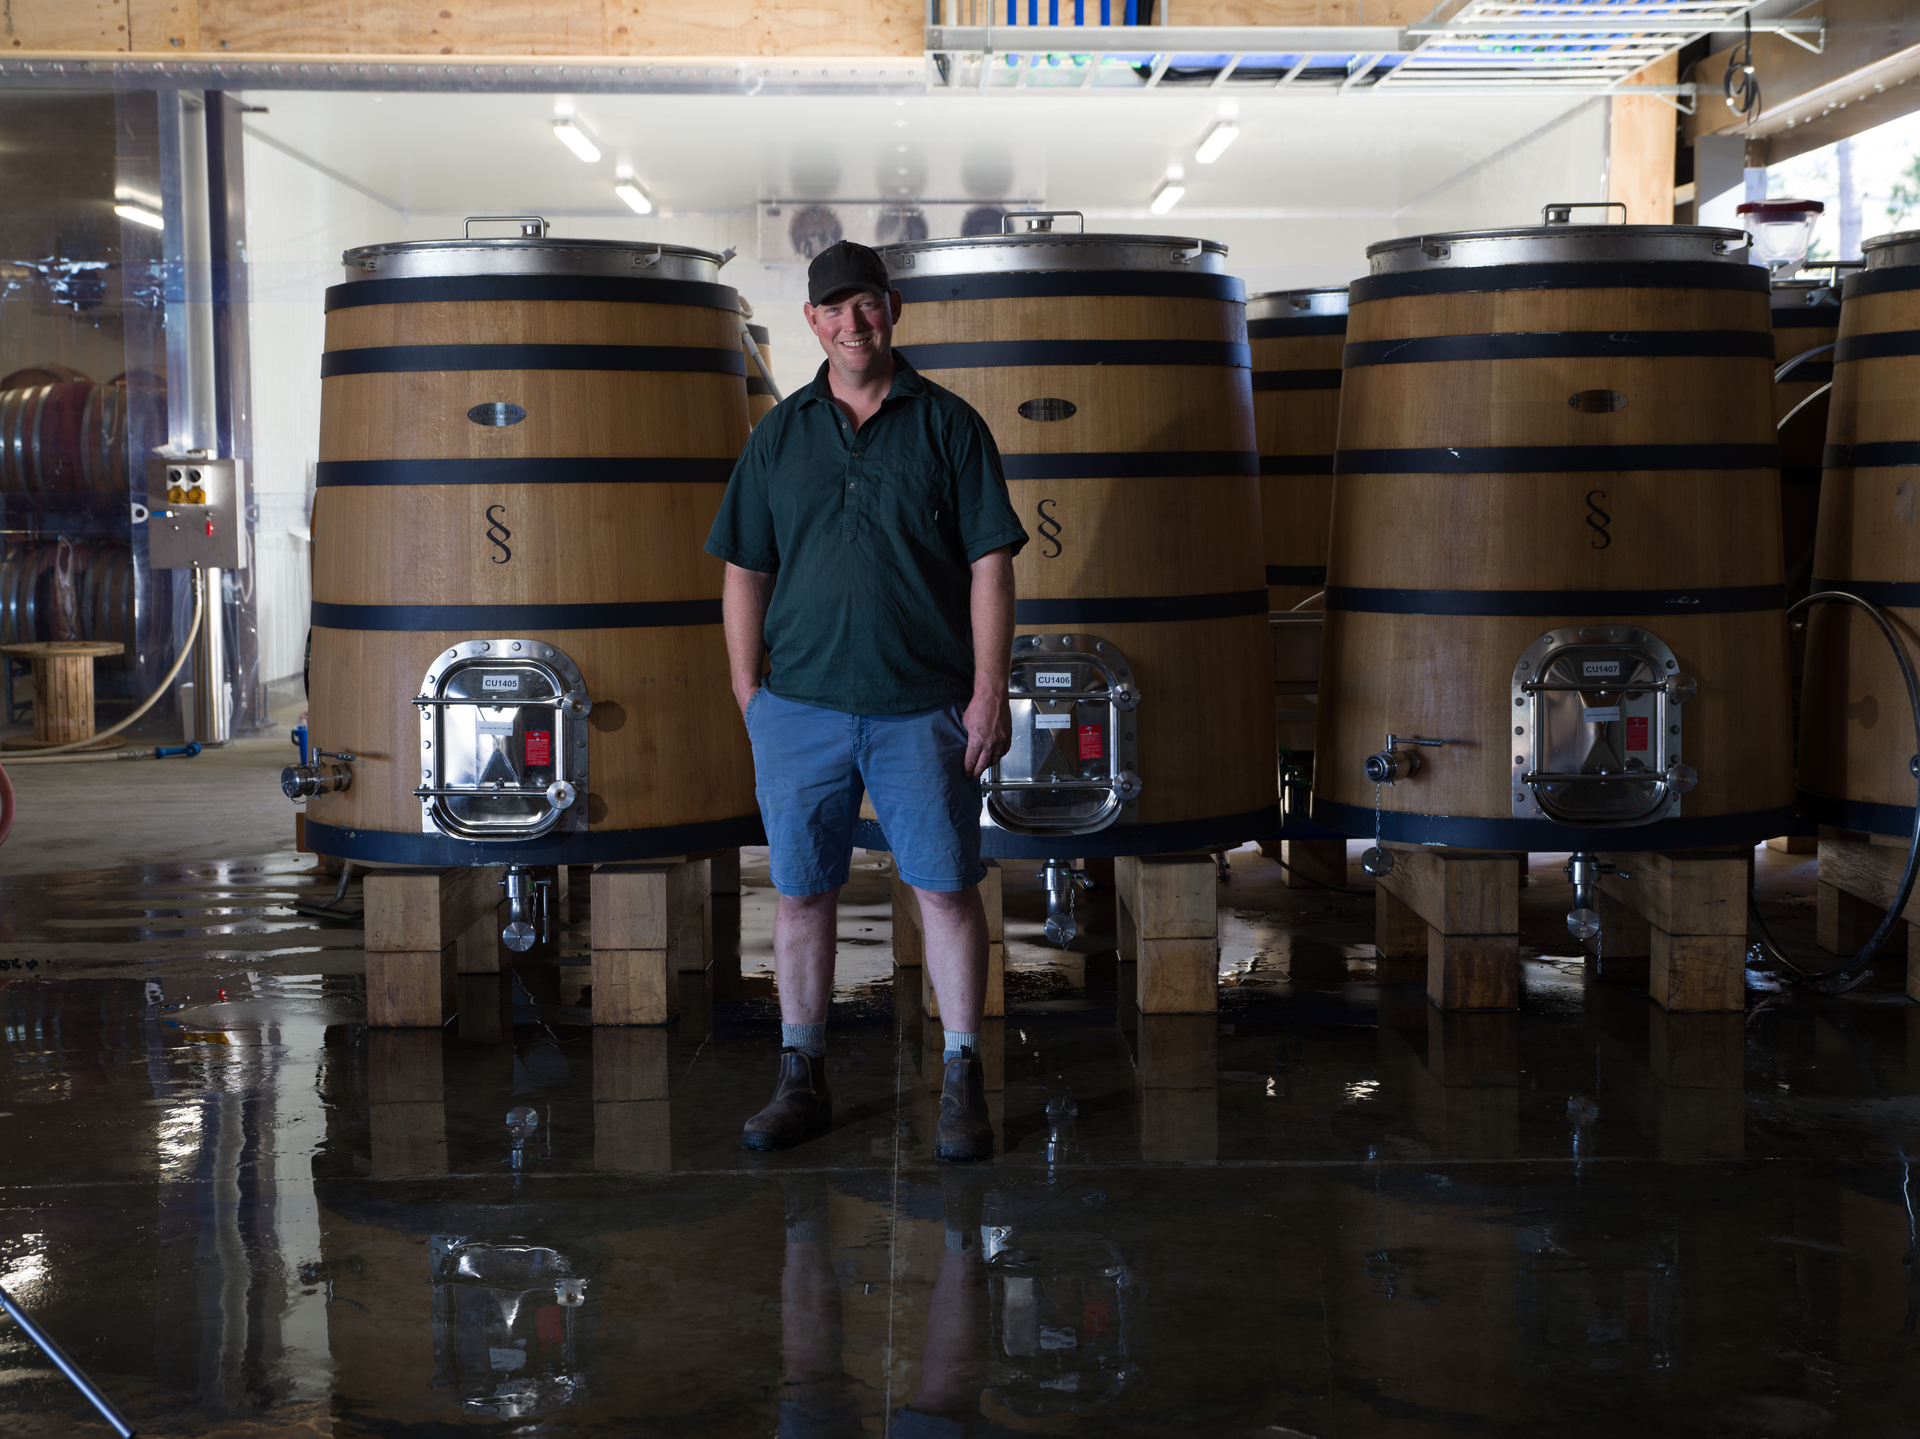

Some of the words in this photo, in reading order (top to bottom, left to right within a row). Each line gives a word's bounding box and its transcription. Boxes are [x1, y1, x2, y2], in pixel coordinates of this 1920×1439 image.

[1585, 665, 1618, 673] CU1407
[485, 679, 517, 687] CU1405
[1038, 676, 1070, 684] CU1406
